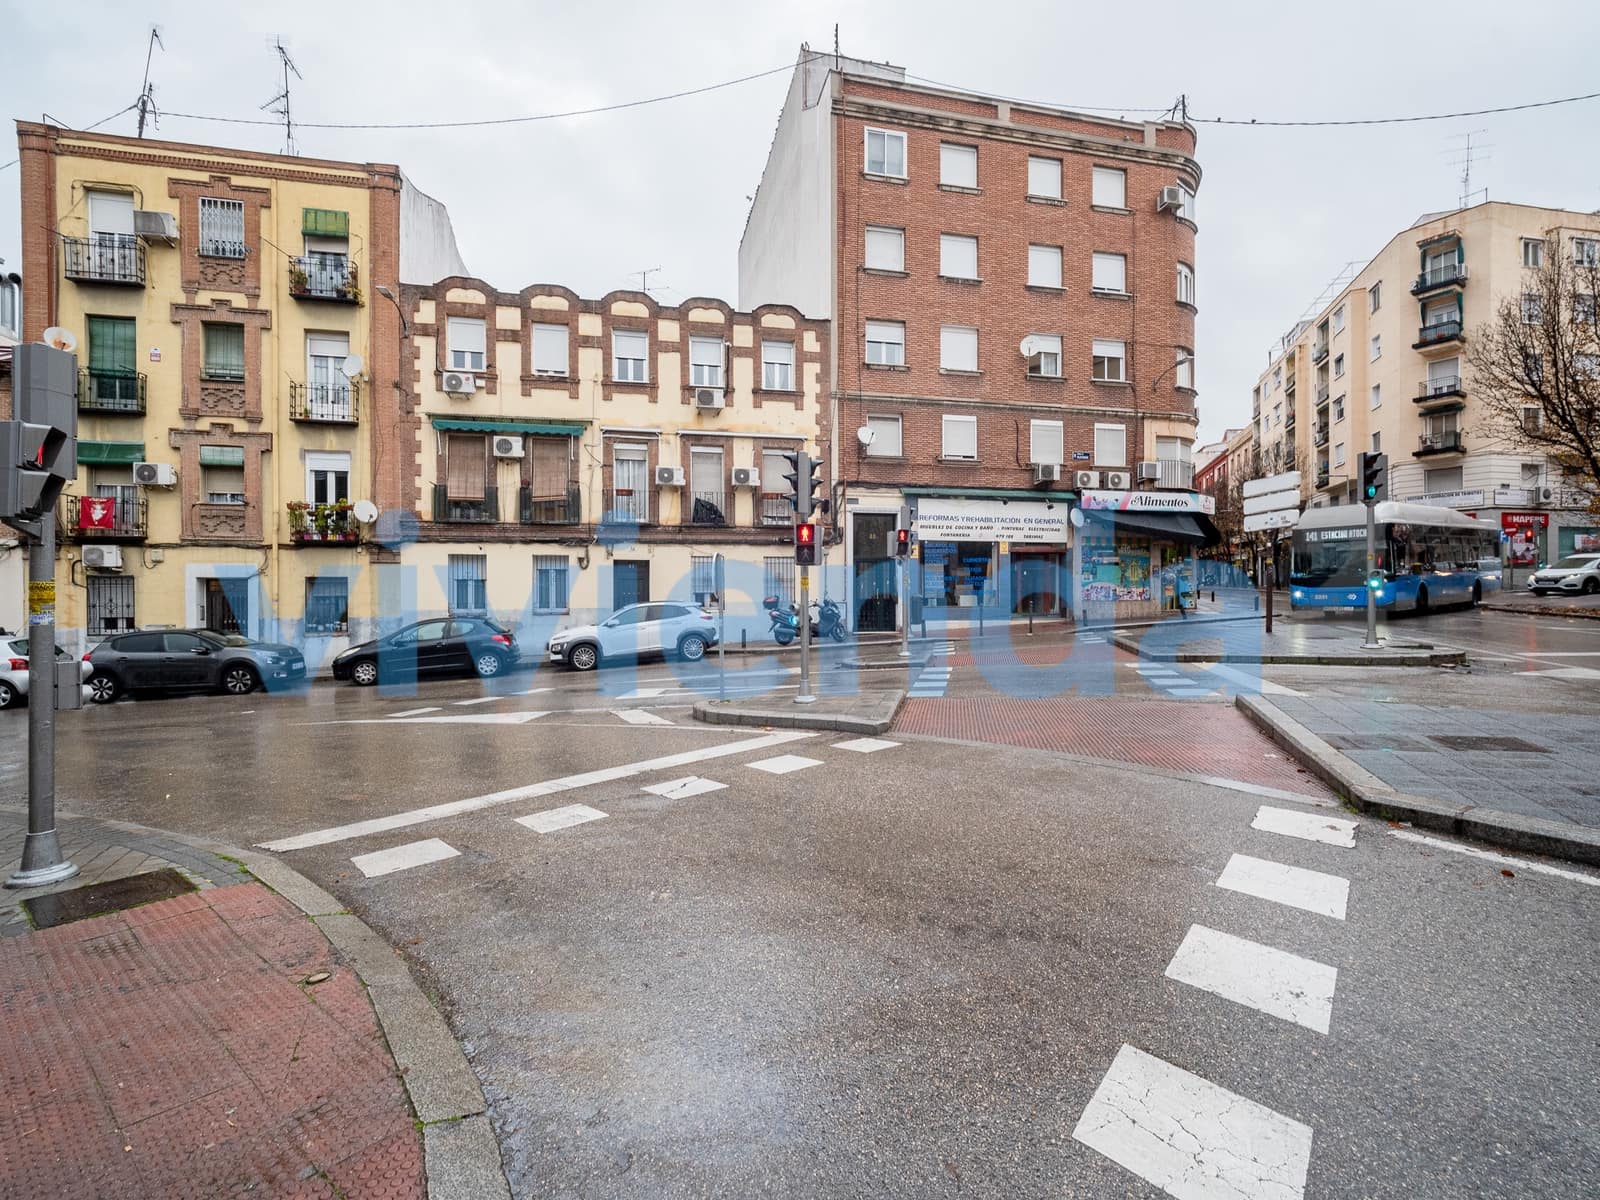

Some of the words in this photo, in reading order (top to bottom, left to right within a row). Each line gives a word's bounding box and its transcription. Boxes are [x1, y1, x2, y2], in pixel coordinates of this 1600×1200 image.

[1130, 495, 1189, 508] Alimentos
[918, 514, 960, 522] REFORMAS
[1023, 516, 1034, 524] EN
[1034, 517, 1065, 526] GENERAL
[1305, 531, 1317, 541] 141
